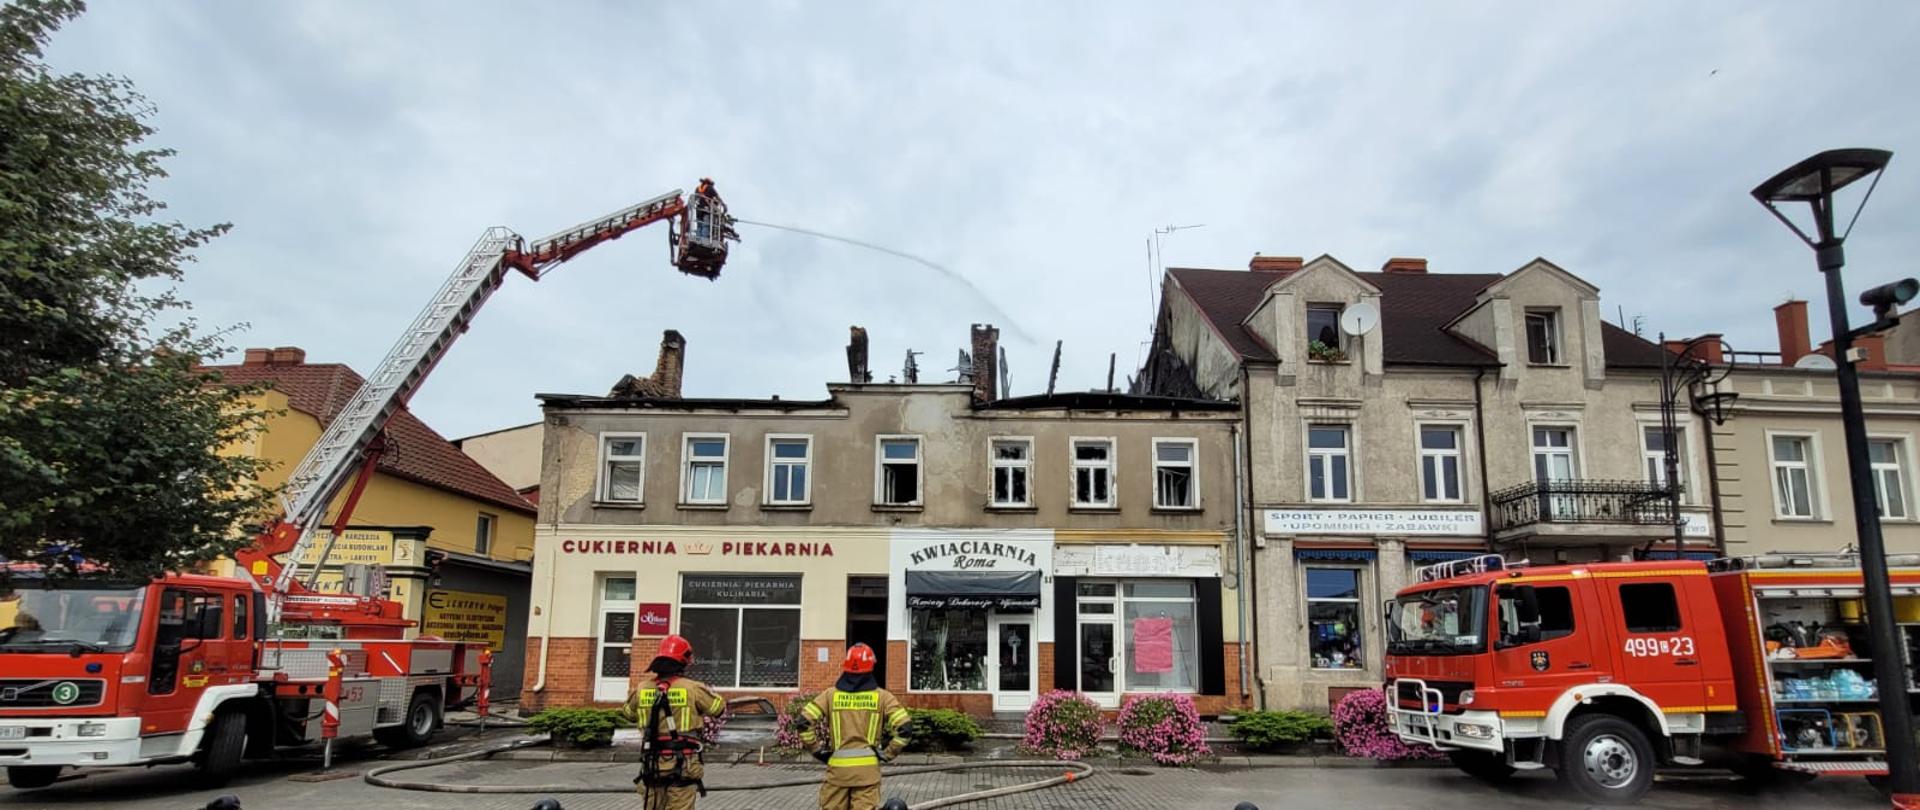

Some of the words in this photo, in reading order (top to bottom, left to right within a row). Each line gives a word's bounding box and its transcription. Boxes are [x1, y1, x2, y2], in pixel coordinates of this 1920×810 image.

[1408, 513, 1475, 522] JUBILER
[1385, 523, 1459, 531] ZABAWKI
[562, 540, 677, 555] CUKIERNIA
[722, 542, 834, 556] PIEKARNIA
[910, 541, 1037, 566] KWIACIARNIA
[953, 555, 997, 569] Roma
[744, 581, 795, 589] PIEKARNIA
[1625, 638, 1659, 657] 499
[1670, 637, 1694, 656] 23
[60, 687, 71, 700] 3
